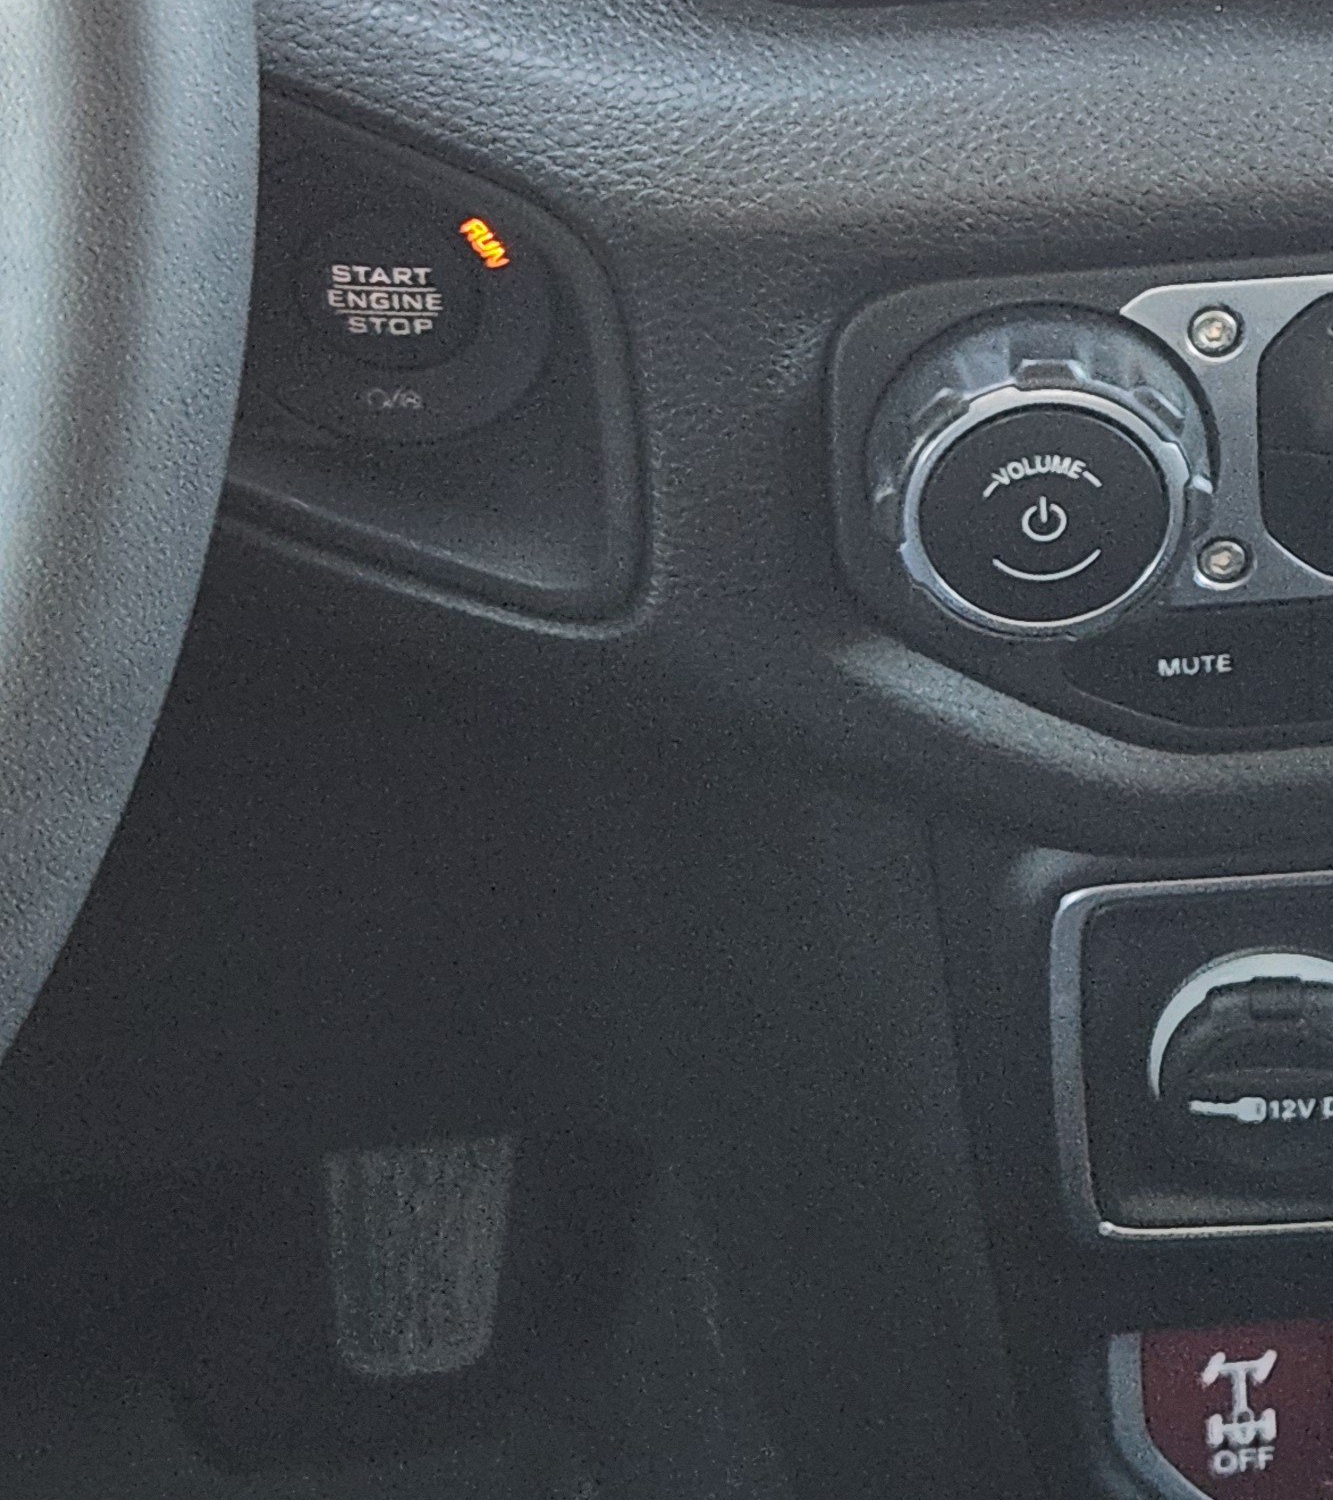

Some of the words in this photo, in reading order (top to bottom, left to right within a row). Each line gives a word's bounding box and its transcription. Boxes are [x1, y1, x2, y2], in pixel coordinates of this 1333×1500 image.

[460, 218, 510, 268] RUN
[331, 264, 431, 284] START
[327, 288, 442, 310] ENGINE
[347, 315, 433, 335] STOP
[993, 456, 1085, 486] VOLUME
[1158, 654, 1232, 677] MUTE
[1268, 1099, 1318, 1122] 12V
[1212, 1445, 1276, 1475] OFF
